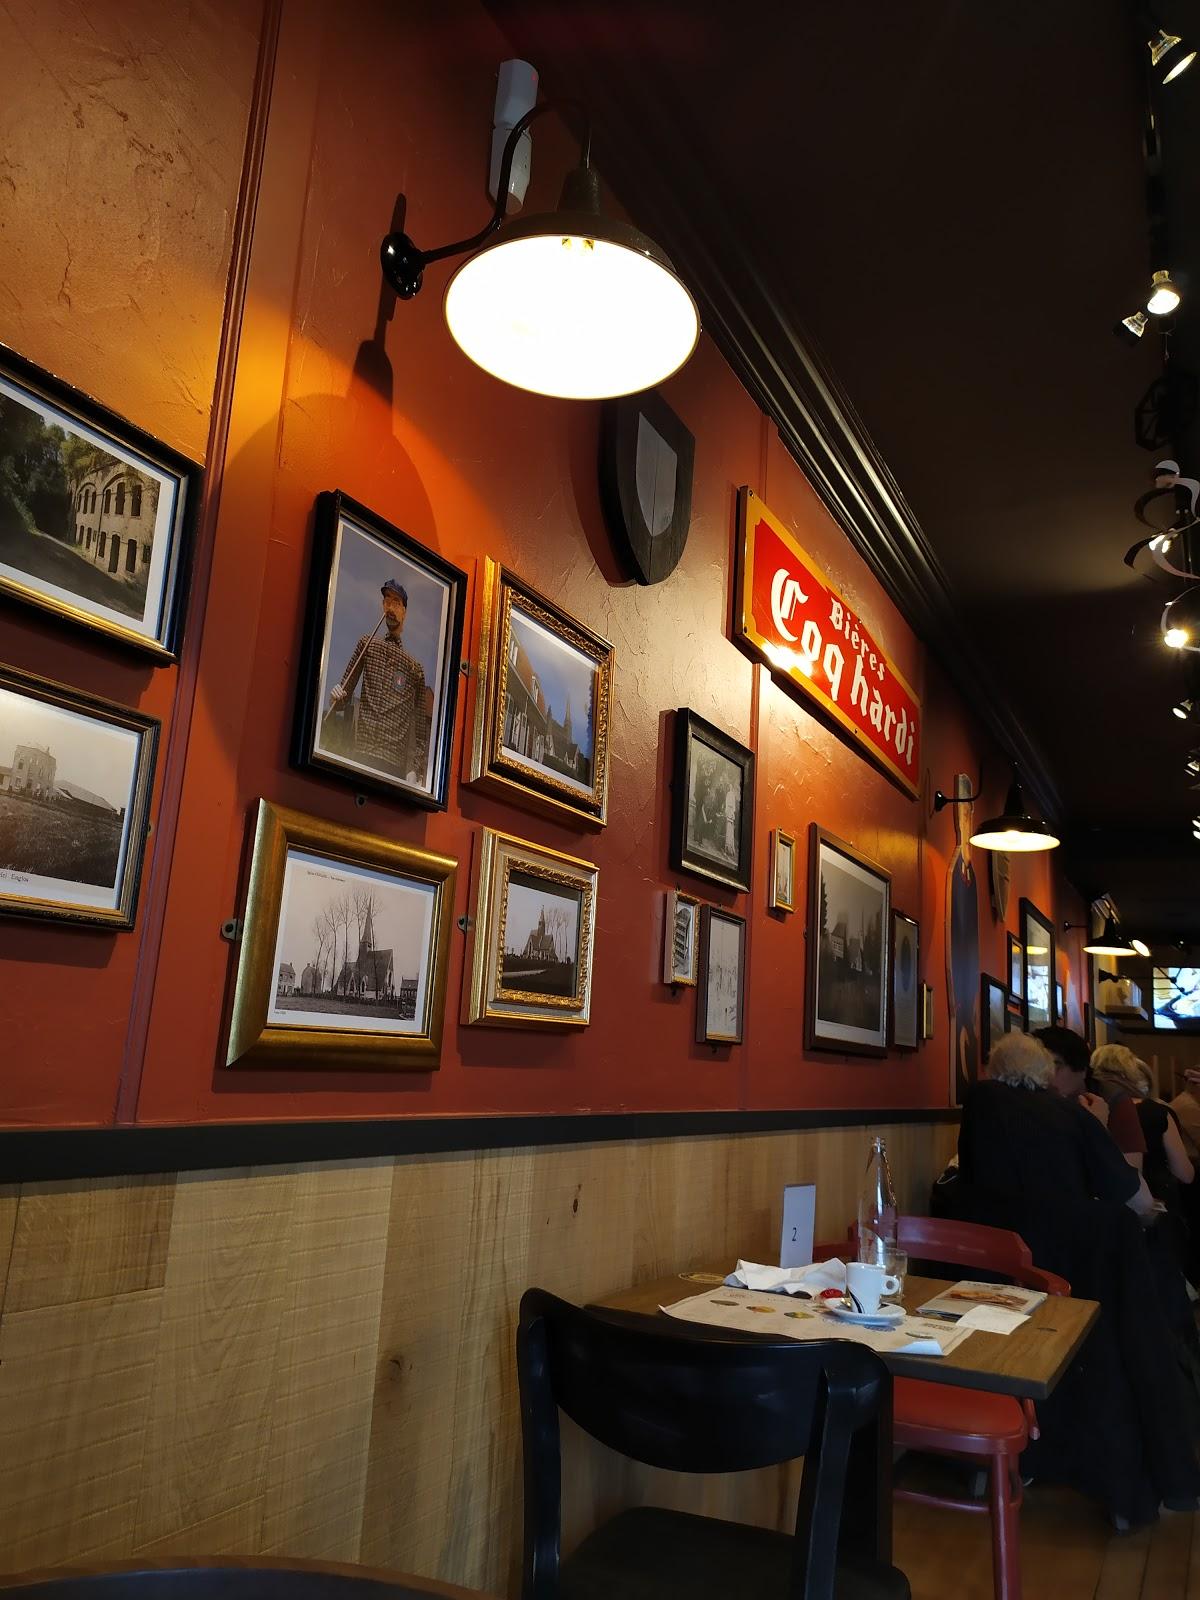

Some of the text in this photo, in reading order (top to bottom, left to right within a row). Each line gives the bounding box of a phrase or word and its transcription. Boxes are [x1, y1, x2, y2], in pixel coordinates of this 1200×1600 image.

[770, 567, 845, 702] Coq
[830, 596, 886, 681] Bières
[791, 1227, 798, 1242] 2
